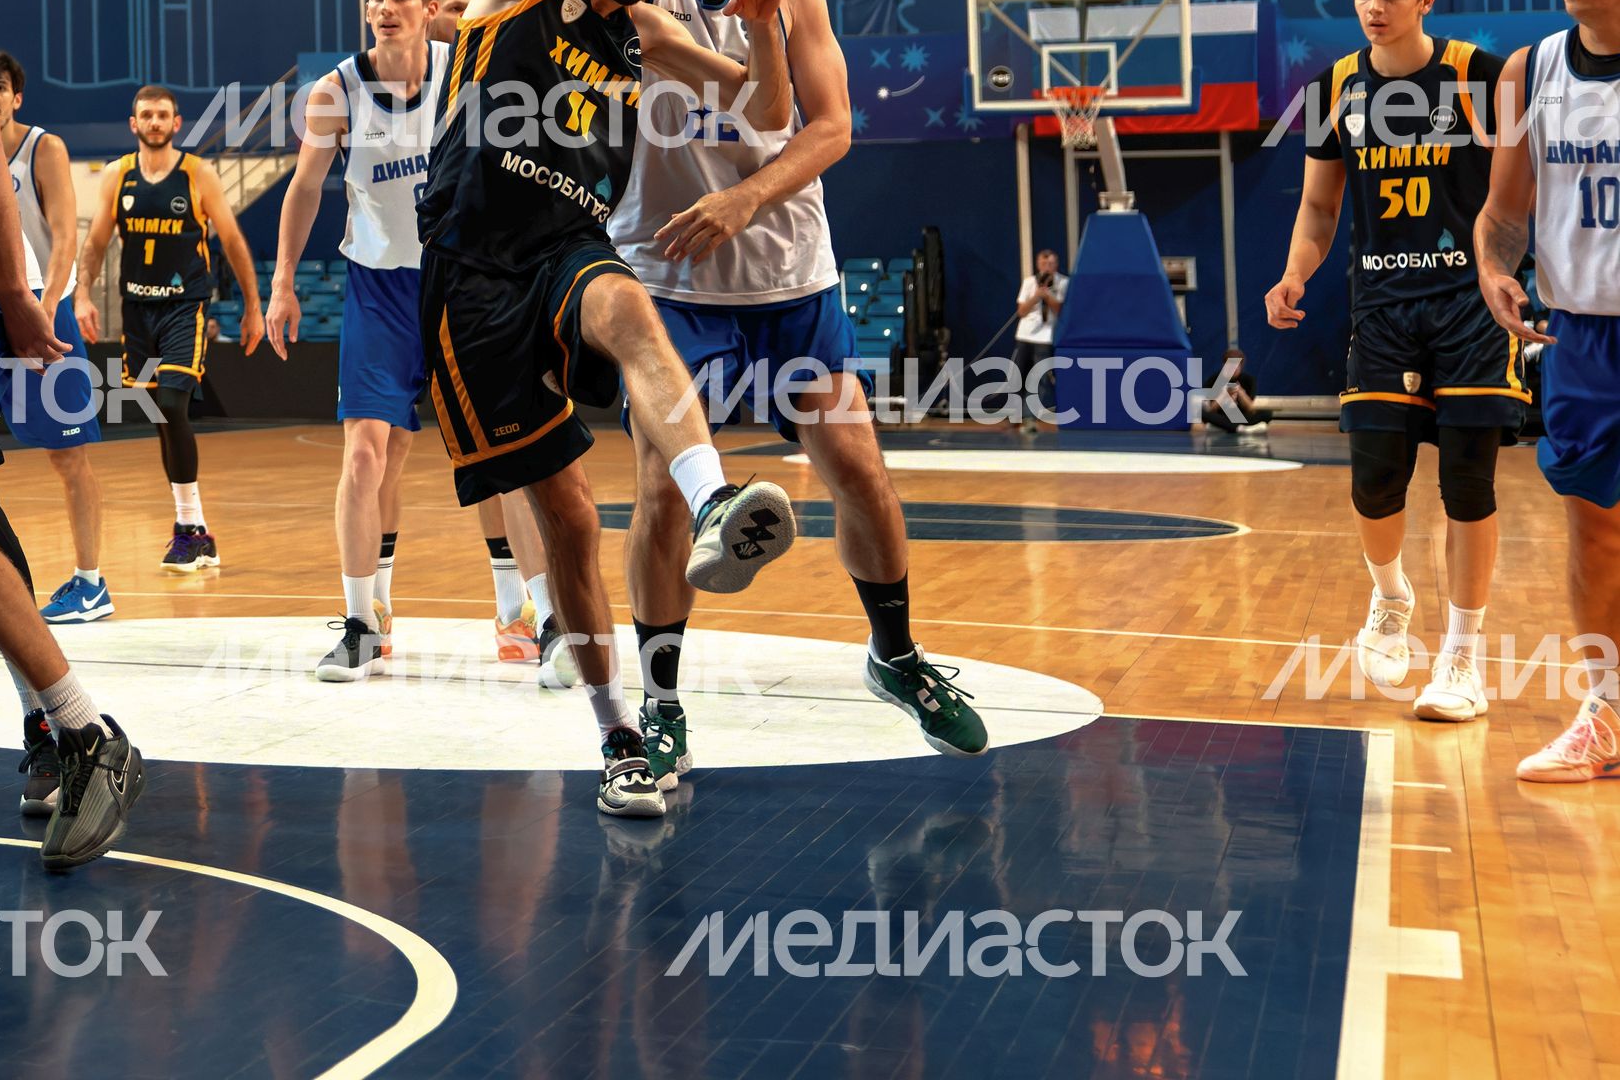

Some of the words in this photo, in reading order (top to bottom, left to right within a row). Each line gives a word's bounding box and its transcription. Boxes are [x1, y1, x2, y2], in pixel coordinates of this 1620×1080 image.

[372, 153, 429, 183] ДИНА
[1355, 142, 1452, 170] ХИМКИ
[500, 150, 611, 224] МОСОБЛГАЗ
[1380, 176, 1430, 219] 50
[1579, 176, 1620, 230] 10
[125, 217, 183, 235] ХИМКИ
[144, 239, 155, 265] 1
[1362, 250, 1468, 271] МОСОБЛГАЗ
[492, 423, 520, 437] ZEDO
